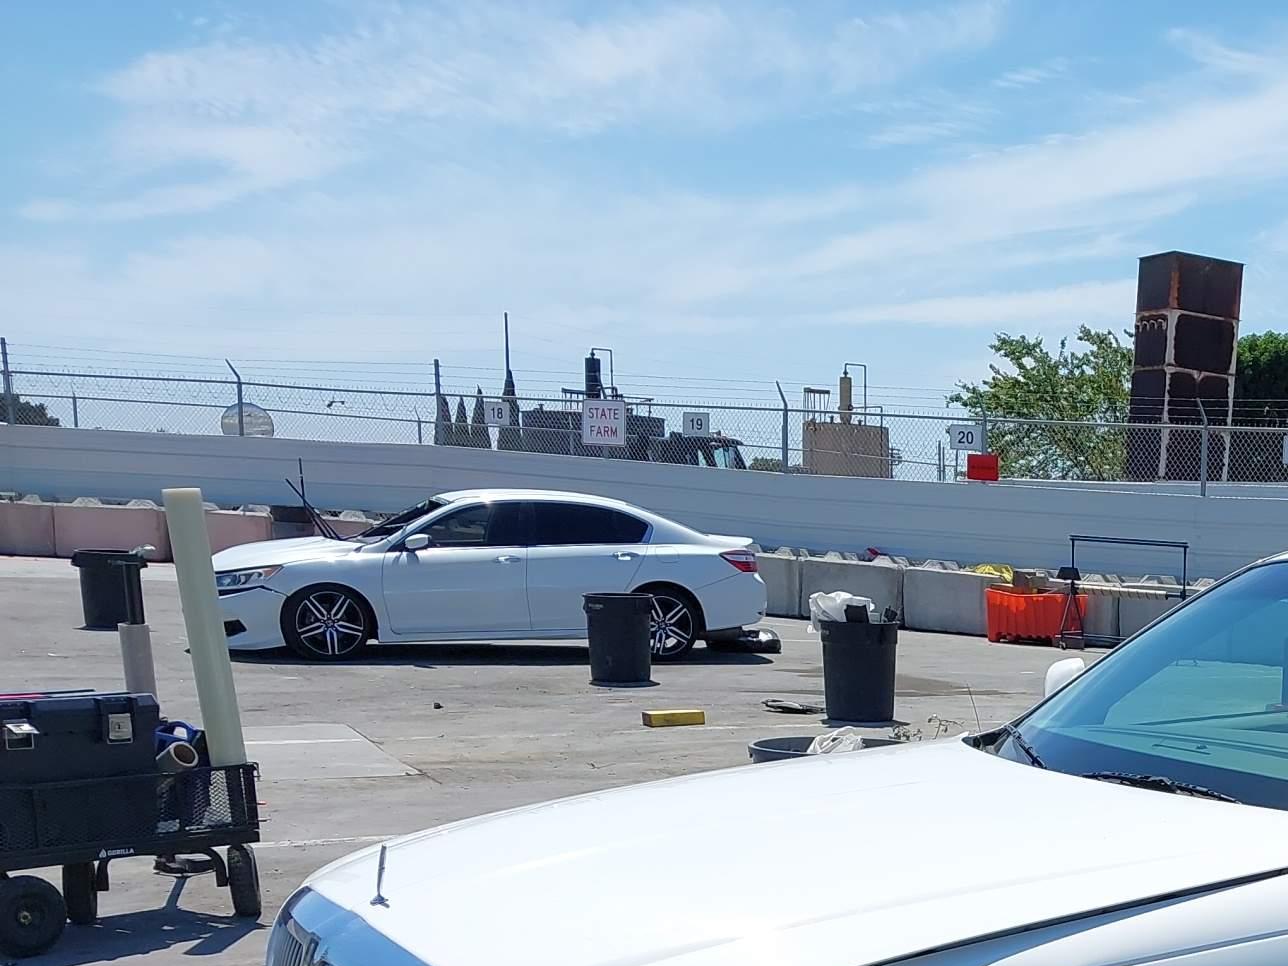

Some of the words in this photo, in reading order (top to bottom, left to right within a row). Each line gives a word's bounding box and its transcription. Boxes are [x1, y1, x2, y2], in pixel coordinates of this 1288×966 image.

[490, 407, 503, 420] 18
[588, 407, 620, 421] STATE
[689, 417, 703, 430] 19
[590, 428, 618, 438] FARM
[957, 431, 974, 445] 20
